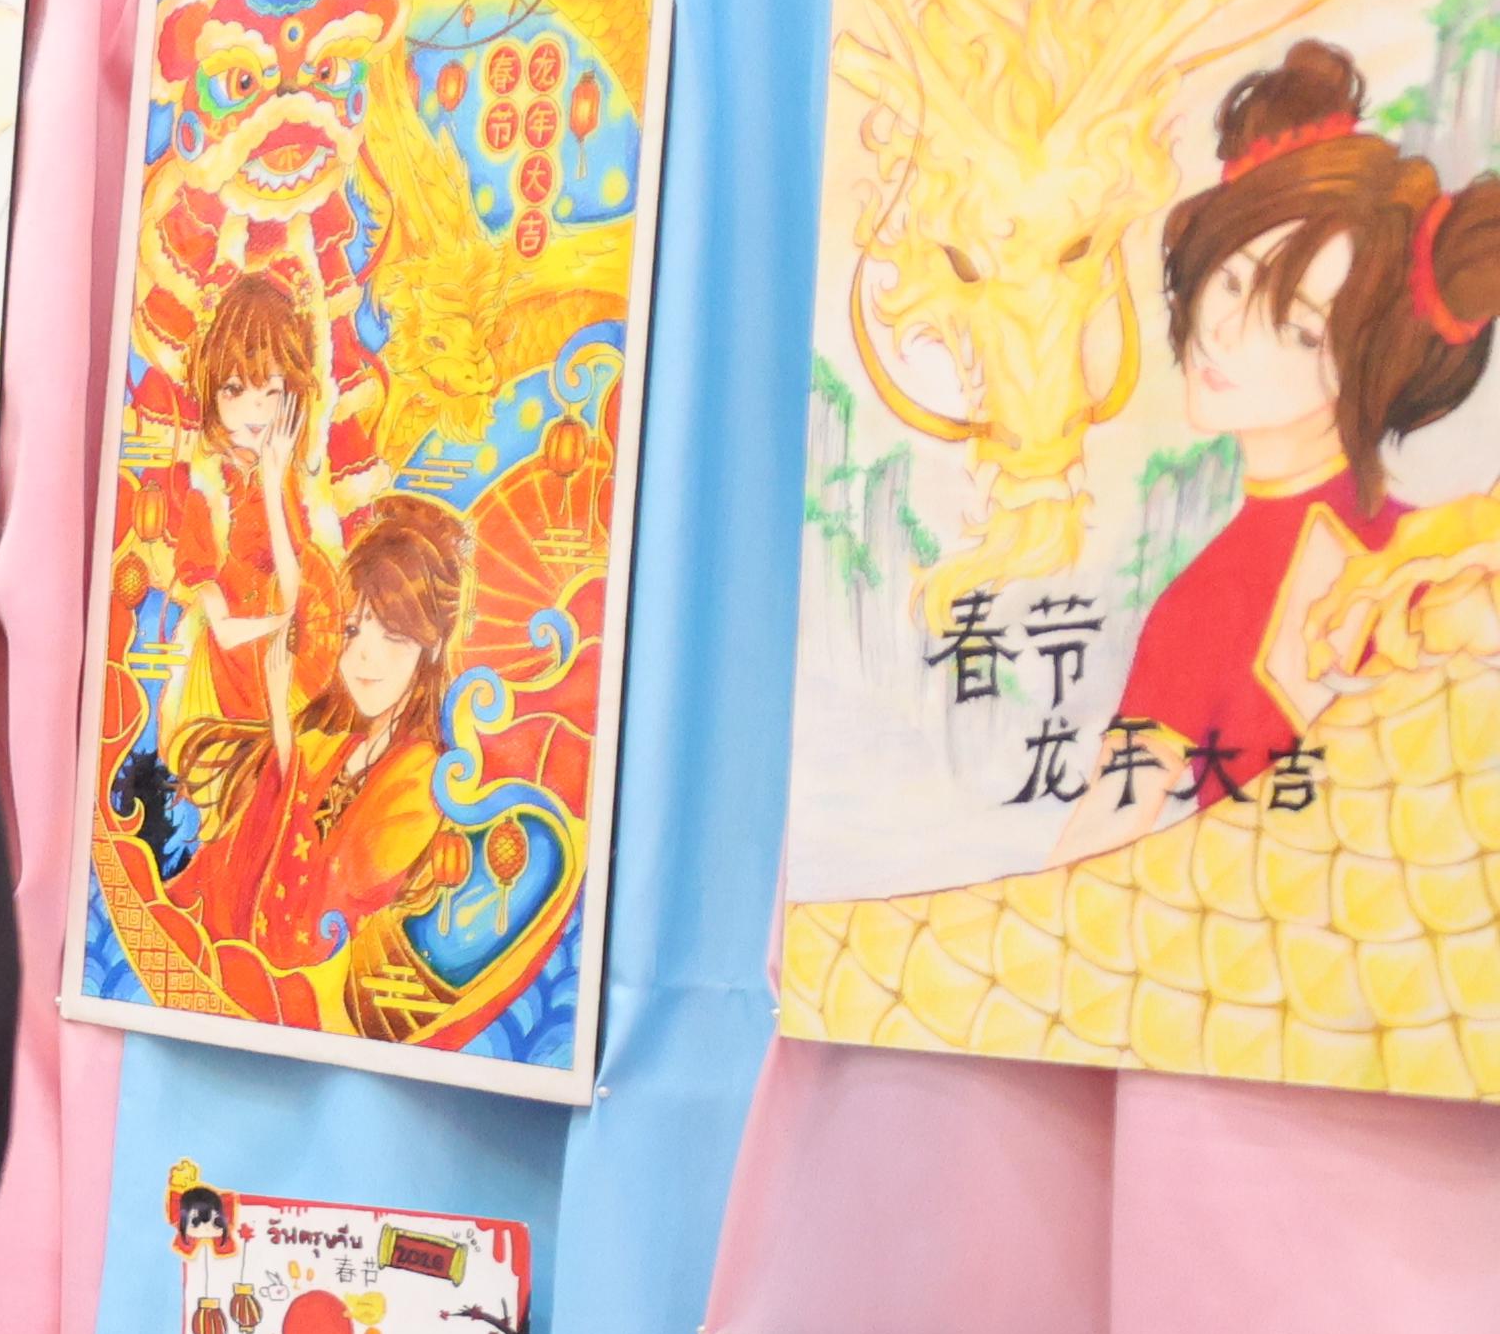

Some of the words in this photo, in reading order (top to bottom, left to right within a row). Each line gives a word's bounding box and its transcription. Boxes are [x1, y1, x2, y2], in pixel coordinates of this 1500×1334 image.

[521, 50, 556, 253] 龙年大吉
[924, 588, 1106, 708] 春节
[1001, 711, 1331, 814] 龙年大吉
[333, 1255, 379, 1287] 春节
